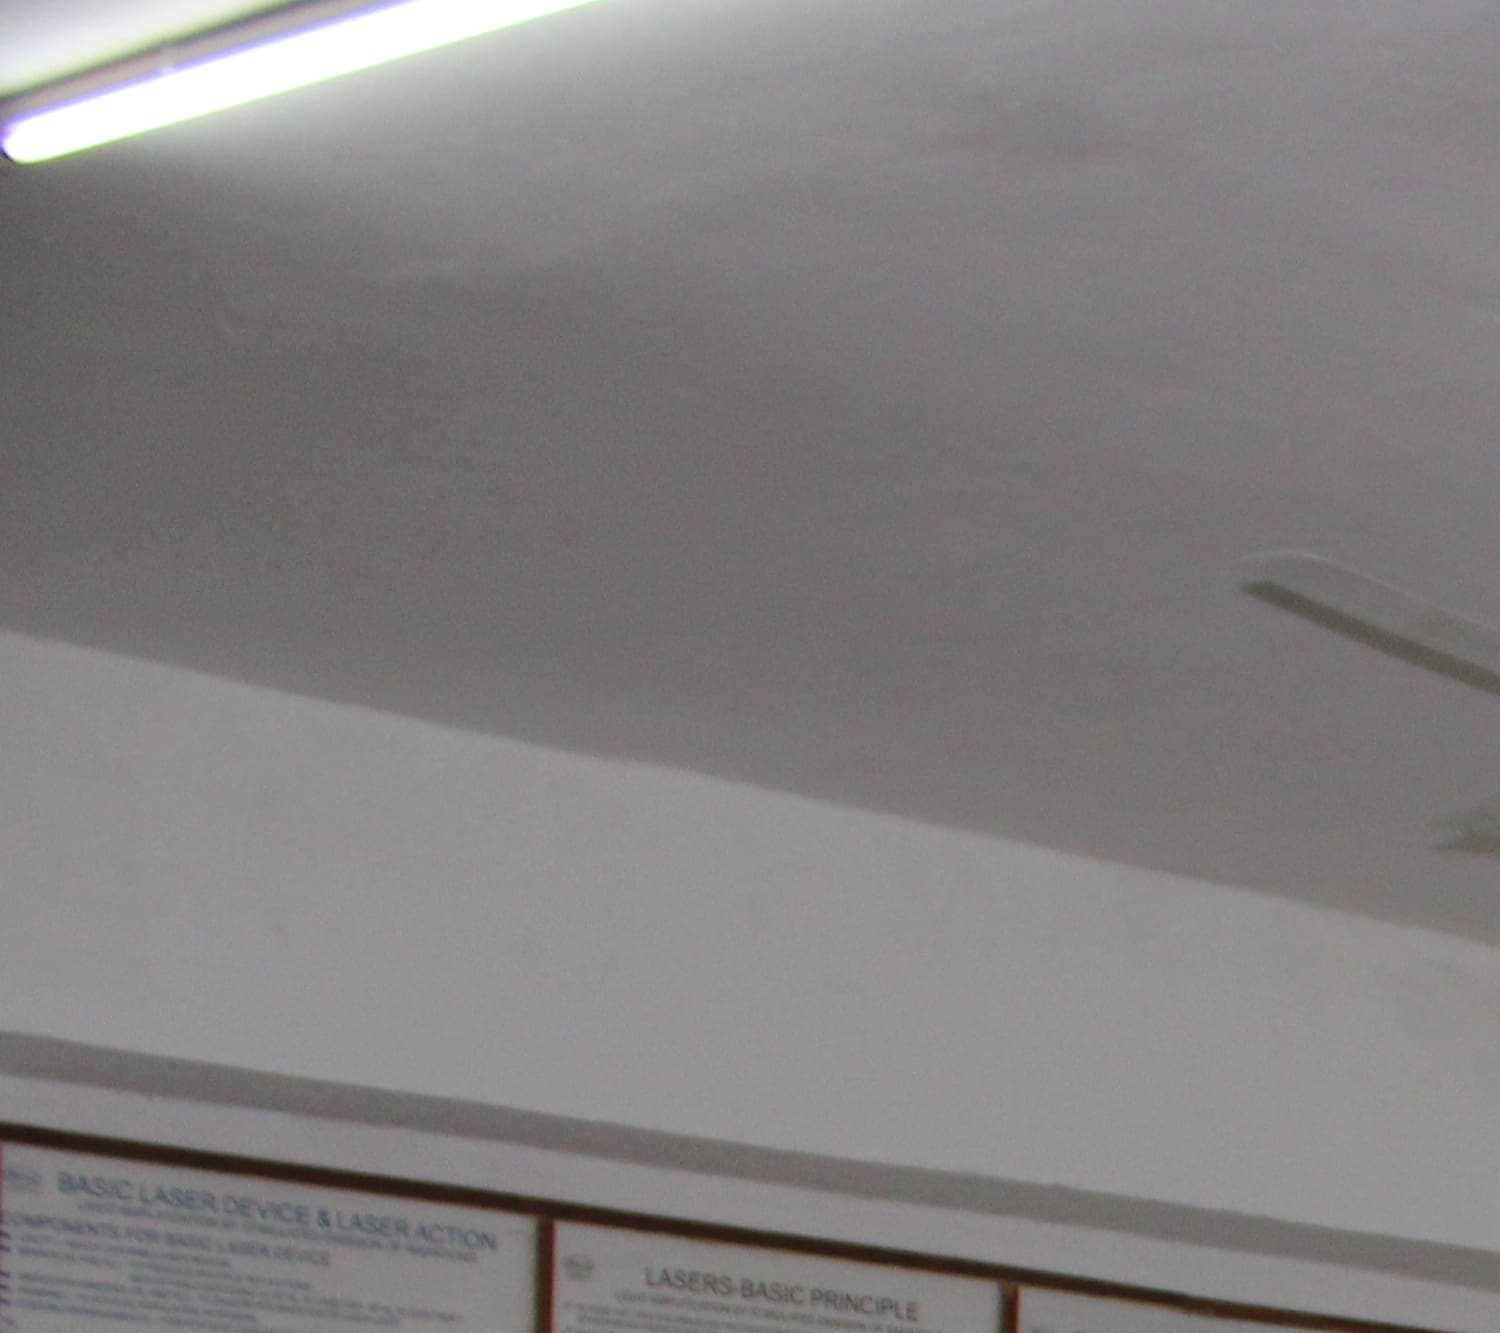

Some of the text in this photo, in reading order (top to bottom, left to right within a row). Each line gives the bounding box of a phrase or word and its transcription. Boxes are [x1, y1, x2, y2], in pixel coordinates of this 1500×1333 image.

[58, 1170, 134, 1200] BASIC
[140, 1183, 217, 1213] LASER
[222, 1194, 310, 1225] DEVICE
[316, 1208, 330, 1230] &
[336, 1209, 409, 1239] LASER
[414, 1221, 496, 1251] ACTION
[809, 1287, 918, 1322] PRINCIPLE
